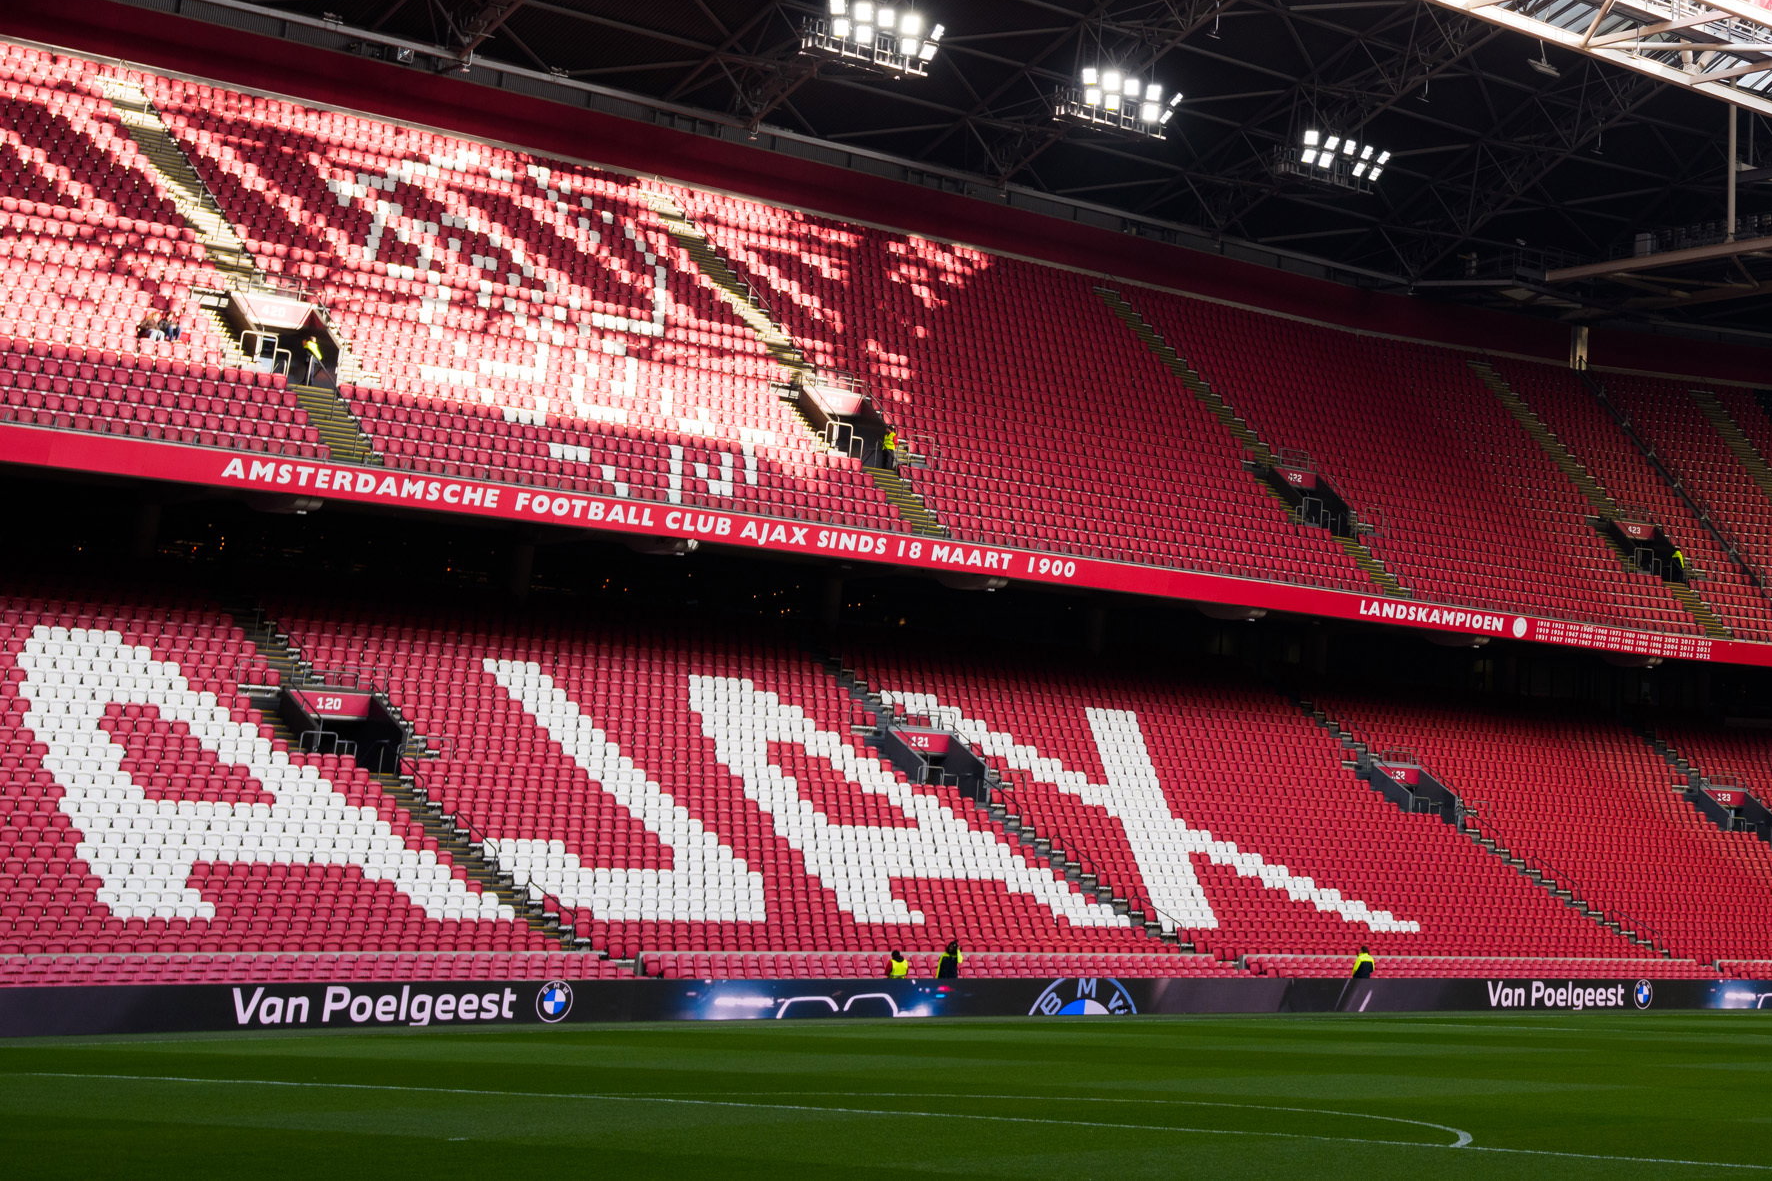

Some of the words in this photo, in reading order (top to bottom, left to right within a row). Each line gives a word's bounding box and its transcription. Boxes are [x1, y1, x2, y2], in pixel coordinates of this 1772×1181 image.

[220, 457, 500, 509] AMSTERDAMSCHE
[514, 492, 654, 527] FOOTBALL
[664, 510, 731, 537] CLUB
[739, 520, 809, 546] AJAX
[816, 530, 887, 555] SINDS
[897, 539, 921, 559] 18
[930, 545, 1013, 570] MAART
[1027, 555, 1076, 578] 1900
[1627, 525, 1641, 534] 423
[1359, 600, 1504, 631] LANDSKAMPIOEN
[316, 696, 342, 710] 120
[16, 625, 1421, 934] AJAX
[232, 986, 311, 1025] Van
[322, 985, 517, 1026] Poelgeest
[1487, 980, 1526, 1008] Van
[1530, 980, 1624, 1010] Poelgeest
